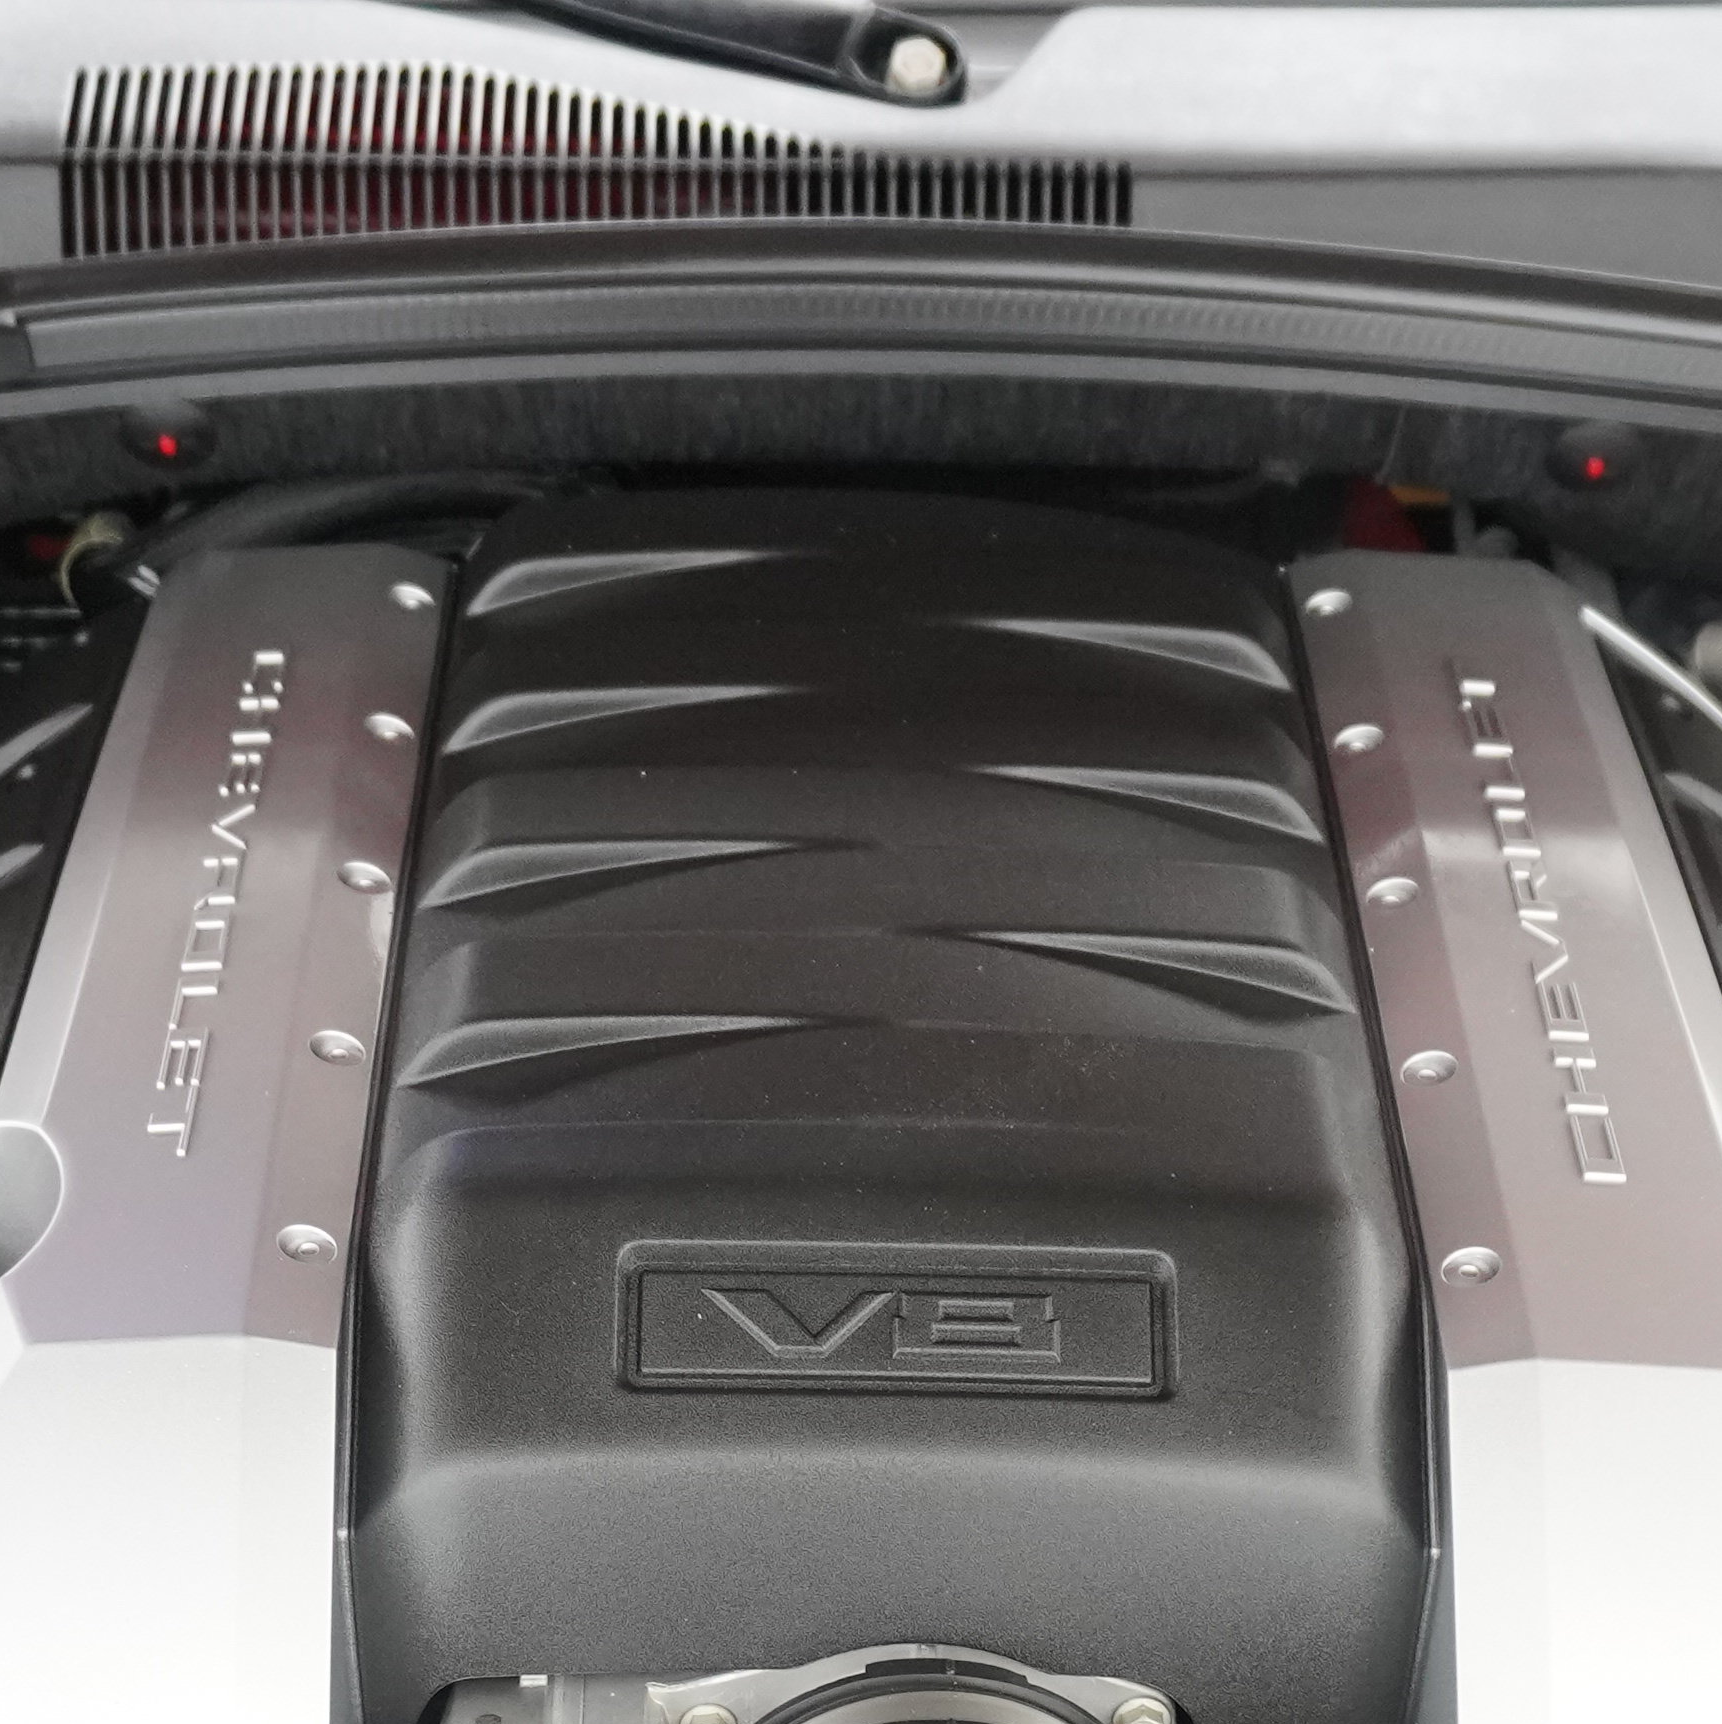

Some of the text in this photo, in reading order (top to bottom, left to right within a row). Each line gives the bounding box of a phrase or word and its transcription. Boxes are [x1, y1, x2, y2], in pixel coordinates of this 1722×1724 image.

[146, 650, 285, 1157] CHEVROLET
[1452, 664, 1628, 1184] CHEVROLET
[699, 1287, 1062, 1365] V8
